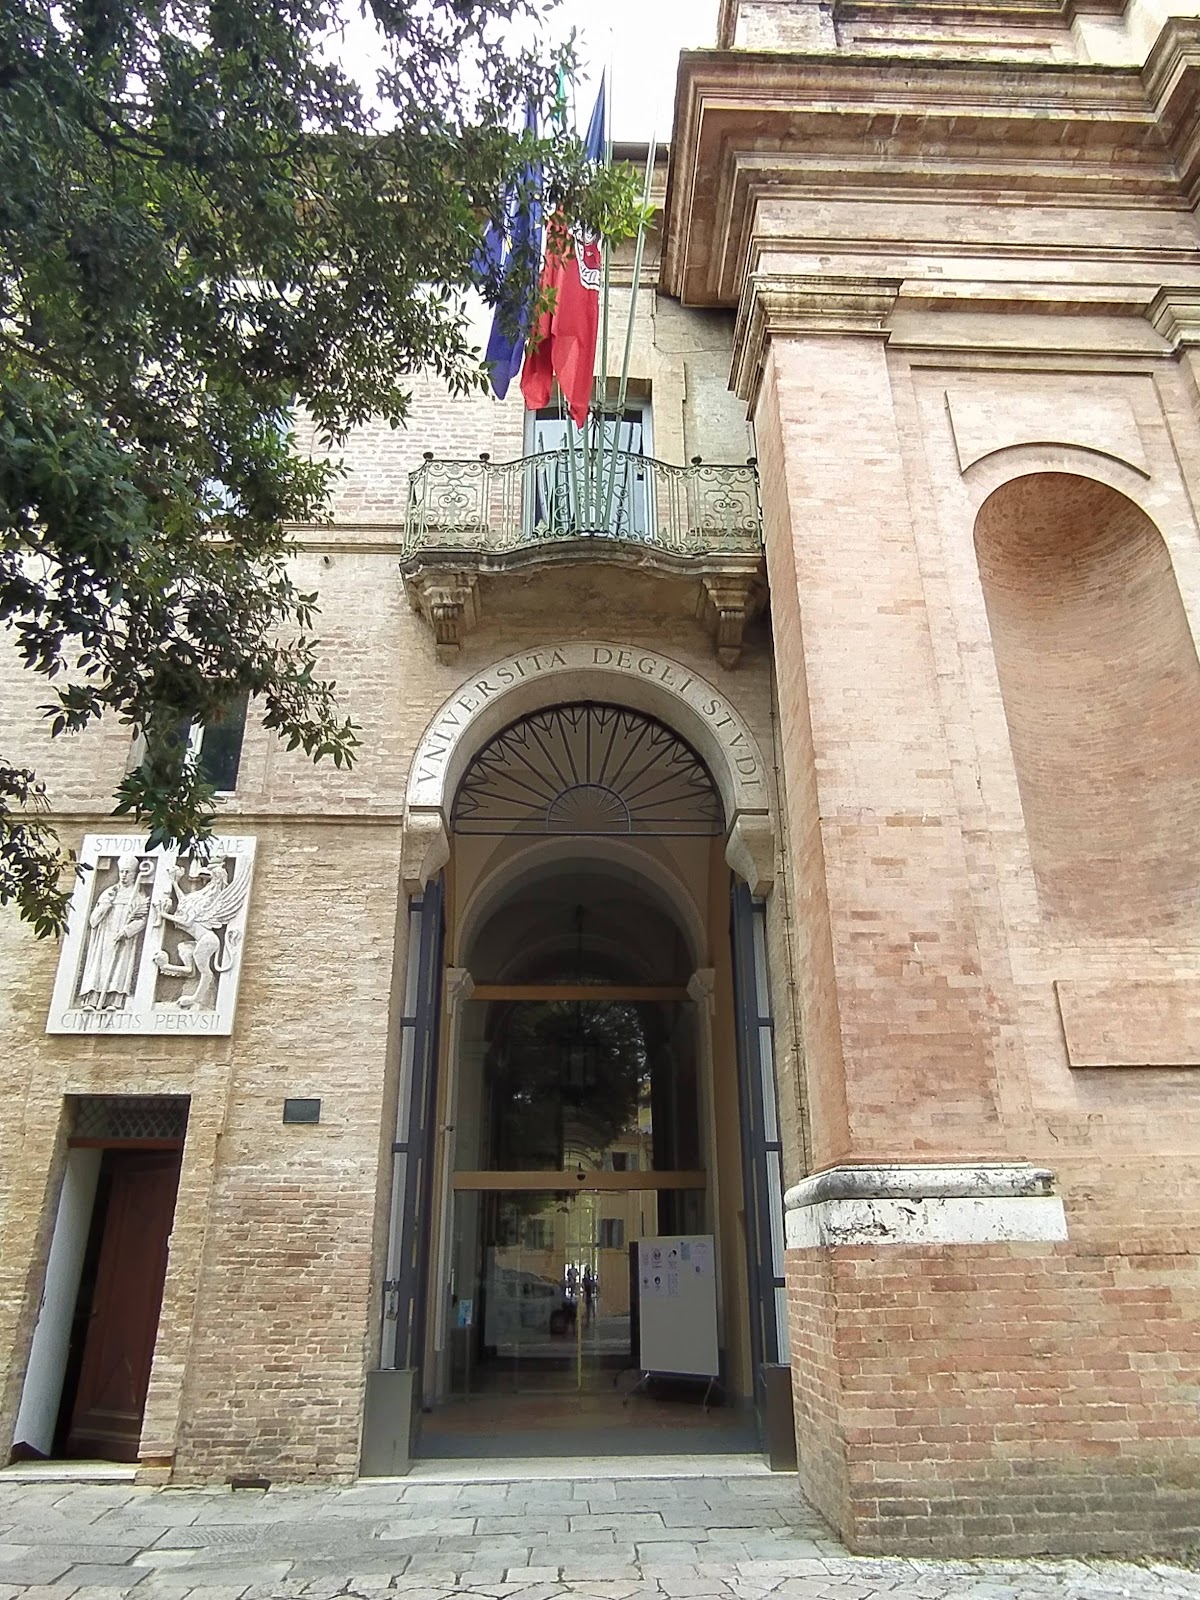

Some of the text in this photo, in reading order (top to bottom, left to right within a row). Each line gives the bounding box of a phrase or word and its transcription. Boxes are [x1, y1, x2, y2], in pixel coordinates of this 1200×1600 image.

[592, 647, 694, 694] DEGLI
[702, 698, 761, 788] STVDI
[94, 837, 148, 853] STVDIV
[60, 1012, 221, 1030] CIVITATIS PERVSII
